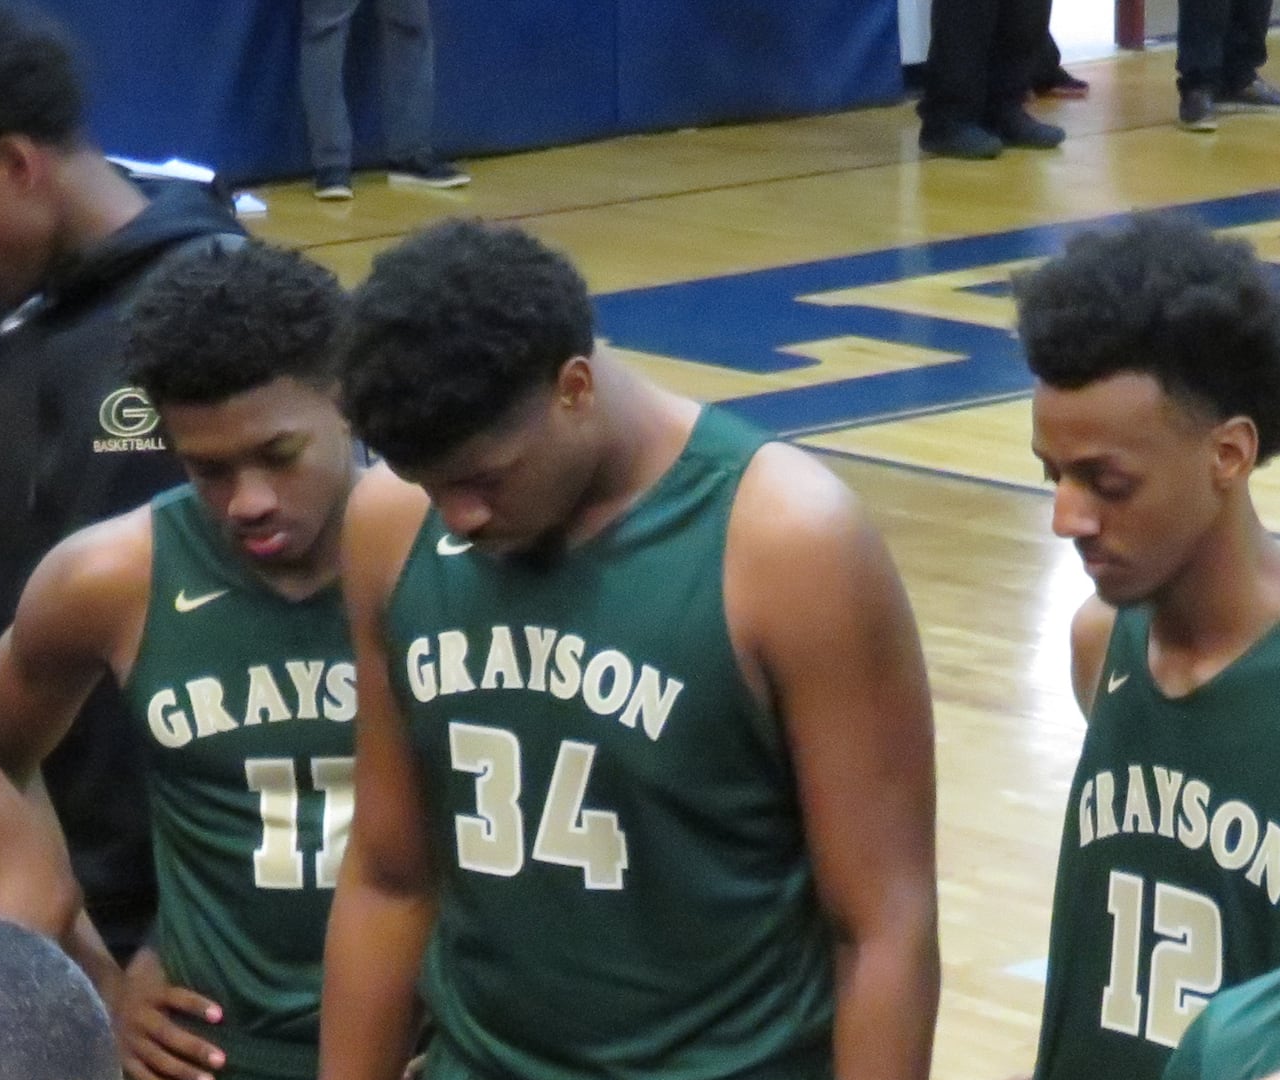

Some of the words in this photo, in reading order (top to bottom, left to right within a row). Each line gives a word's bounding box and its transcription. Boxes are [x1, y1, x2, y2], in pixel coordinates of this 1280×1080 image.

[93, 438, 166, 453] BASKETBALL
[99, 387, 161, 437] G
[147, 659, 357, 748] GRAYS
[406, 625, 683, 741] GRAYSON
[448, 722, 628, 890] 34
[1100, 870, 1223, 1049] 12
